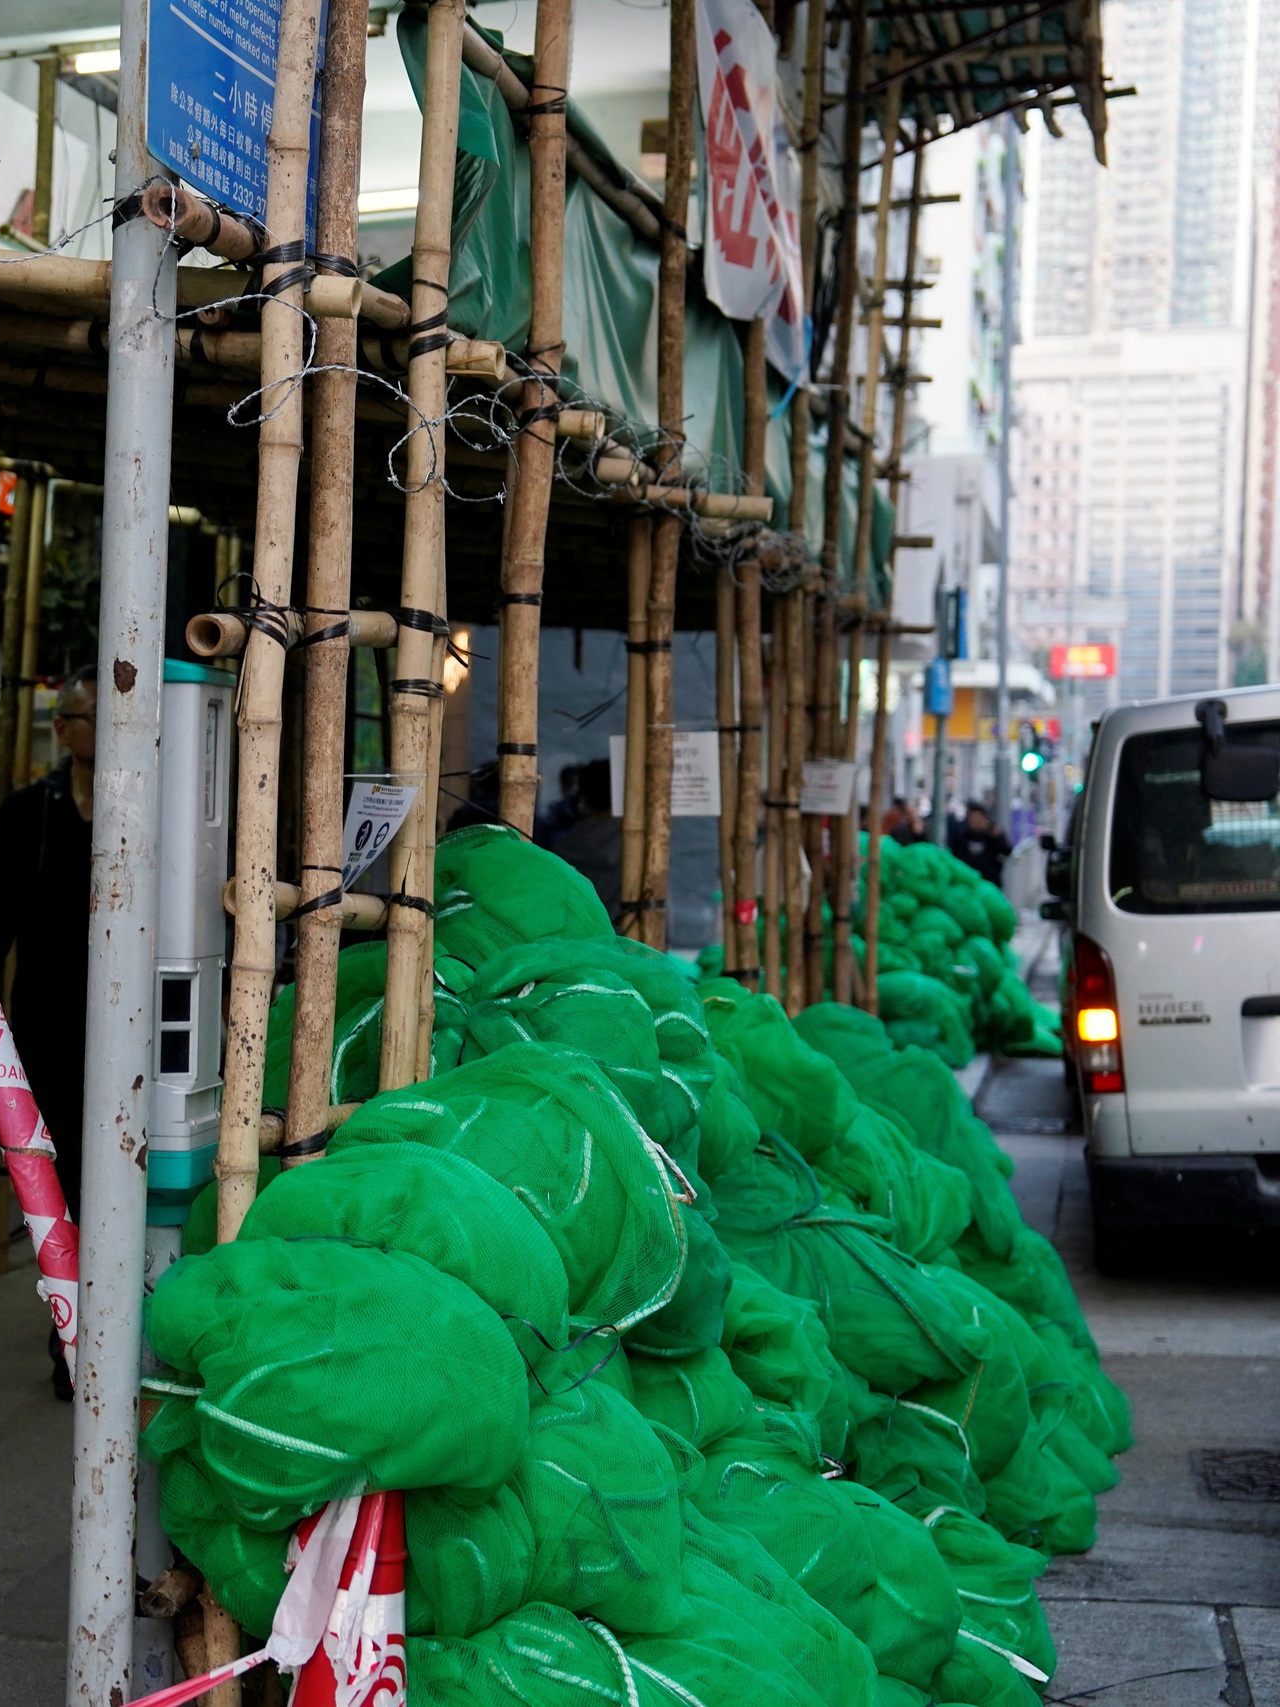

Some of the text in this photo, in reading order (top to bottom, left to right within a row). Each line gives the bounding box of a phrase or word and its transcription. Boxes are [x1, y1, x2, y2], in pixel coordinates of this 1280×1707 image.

[220, 0, 228, 14] of
[230, 7, 249, 30] meter
[251, 22, 275, 50] defects
[245, 0, 276, 33] operating
[208, 13, 234, 40] number
[235, 33, 261, 60] marked
[261, 52, 271, 67] on
[232, 181, 254, 210] 2332
